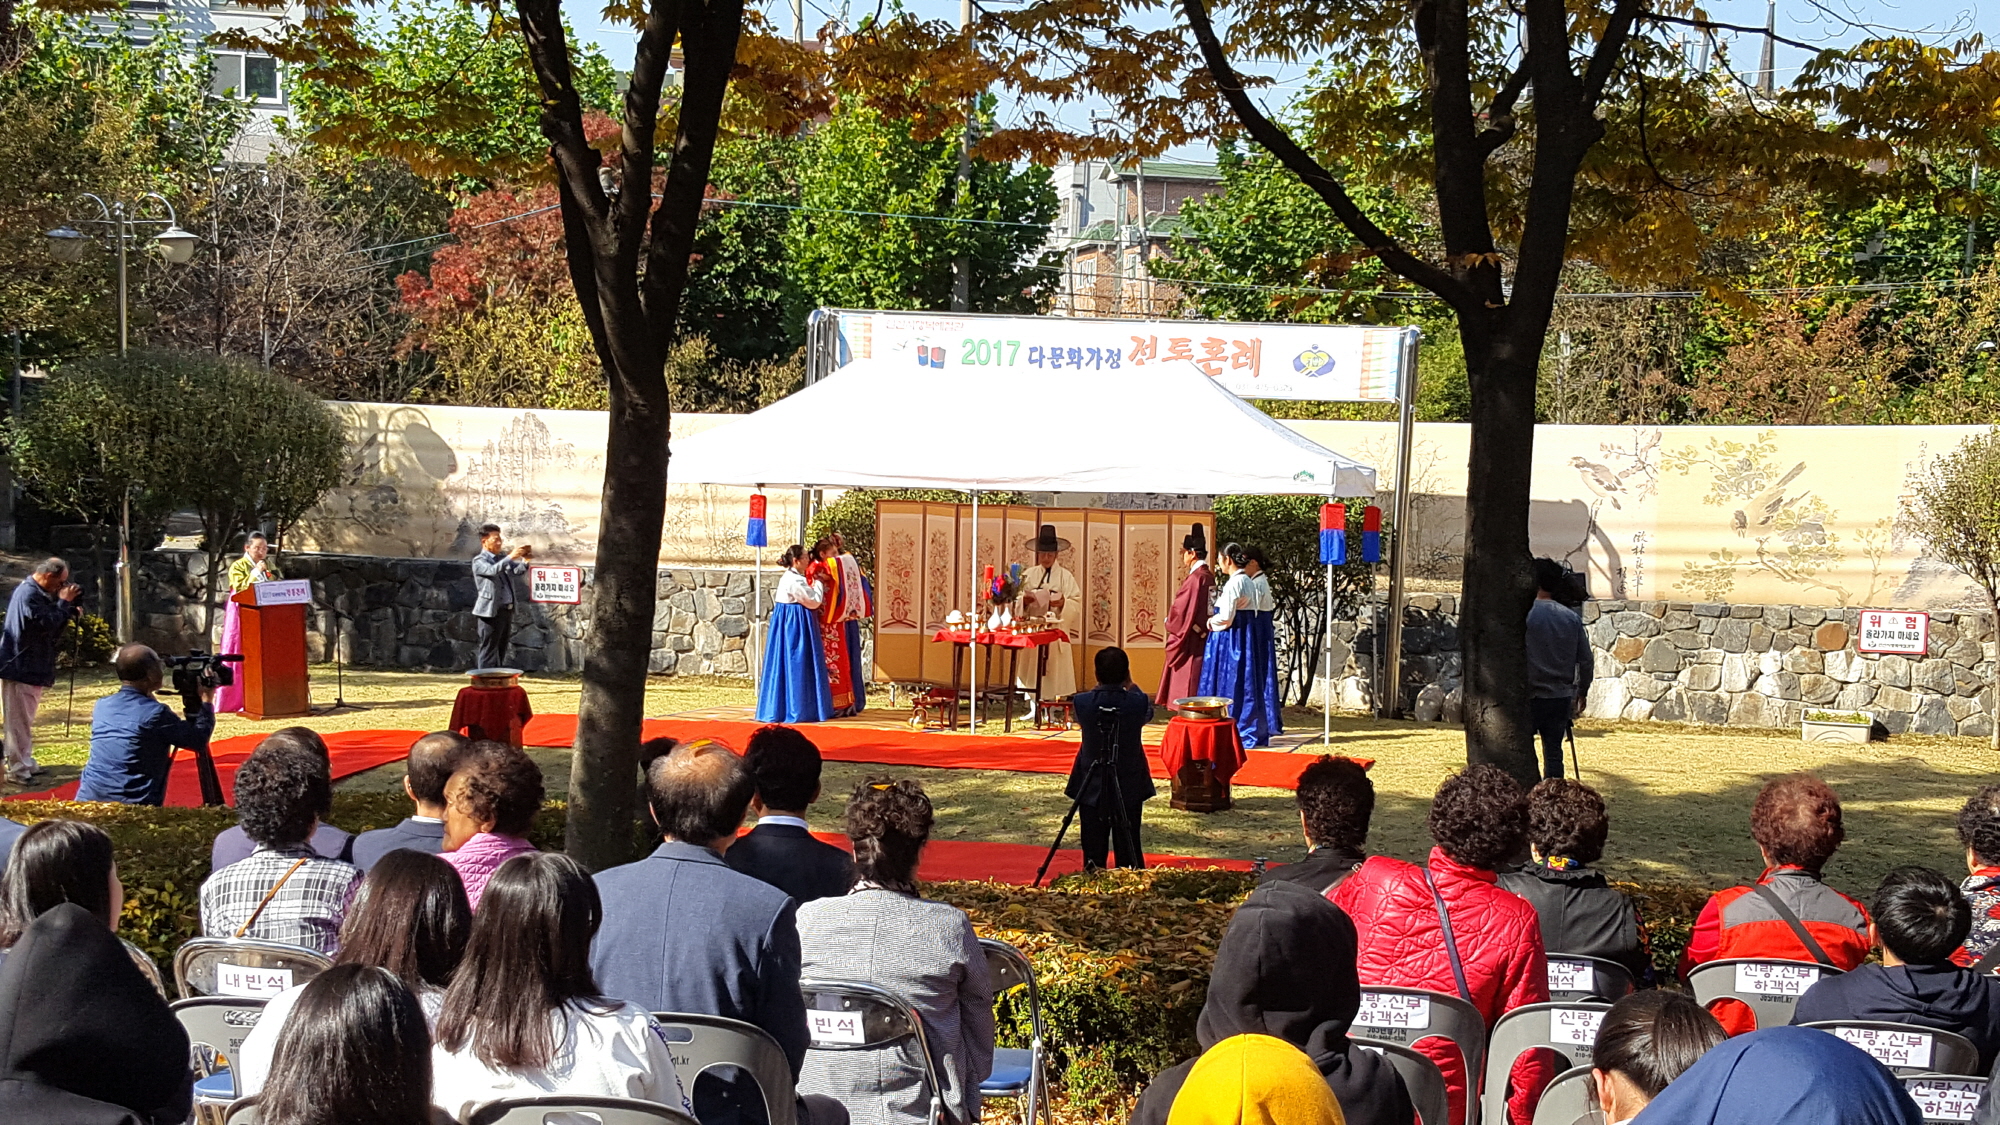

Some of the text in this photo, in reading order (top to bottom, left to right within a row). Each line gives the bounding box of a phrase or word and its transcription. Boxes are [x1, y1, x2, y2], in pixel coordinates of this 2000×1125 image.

[961, 338, 1021, 367] 2017
[1028, 346, 1122, 370] 다문화가정
[1869, 614, 1917, 630] 위 험
[1865, 629, 1920, 641] 올라가지 마세요
[225, 973, 284, 992] 내빈석
[1548, 975, 1574, 988] 객석
[1754, 980, 1799, 994] 하객석
[1360, 1010, 1409, 1026] 하객석
[815, 1017, 855, 1036] 빈석
[1913, 1081, 1986, 1100] 신랑.신
